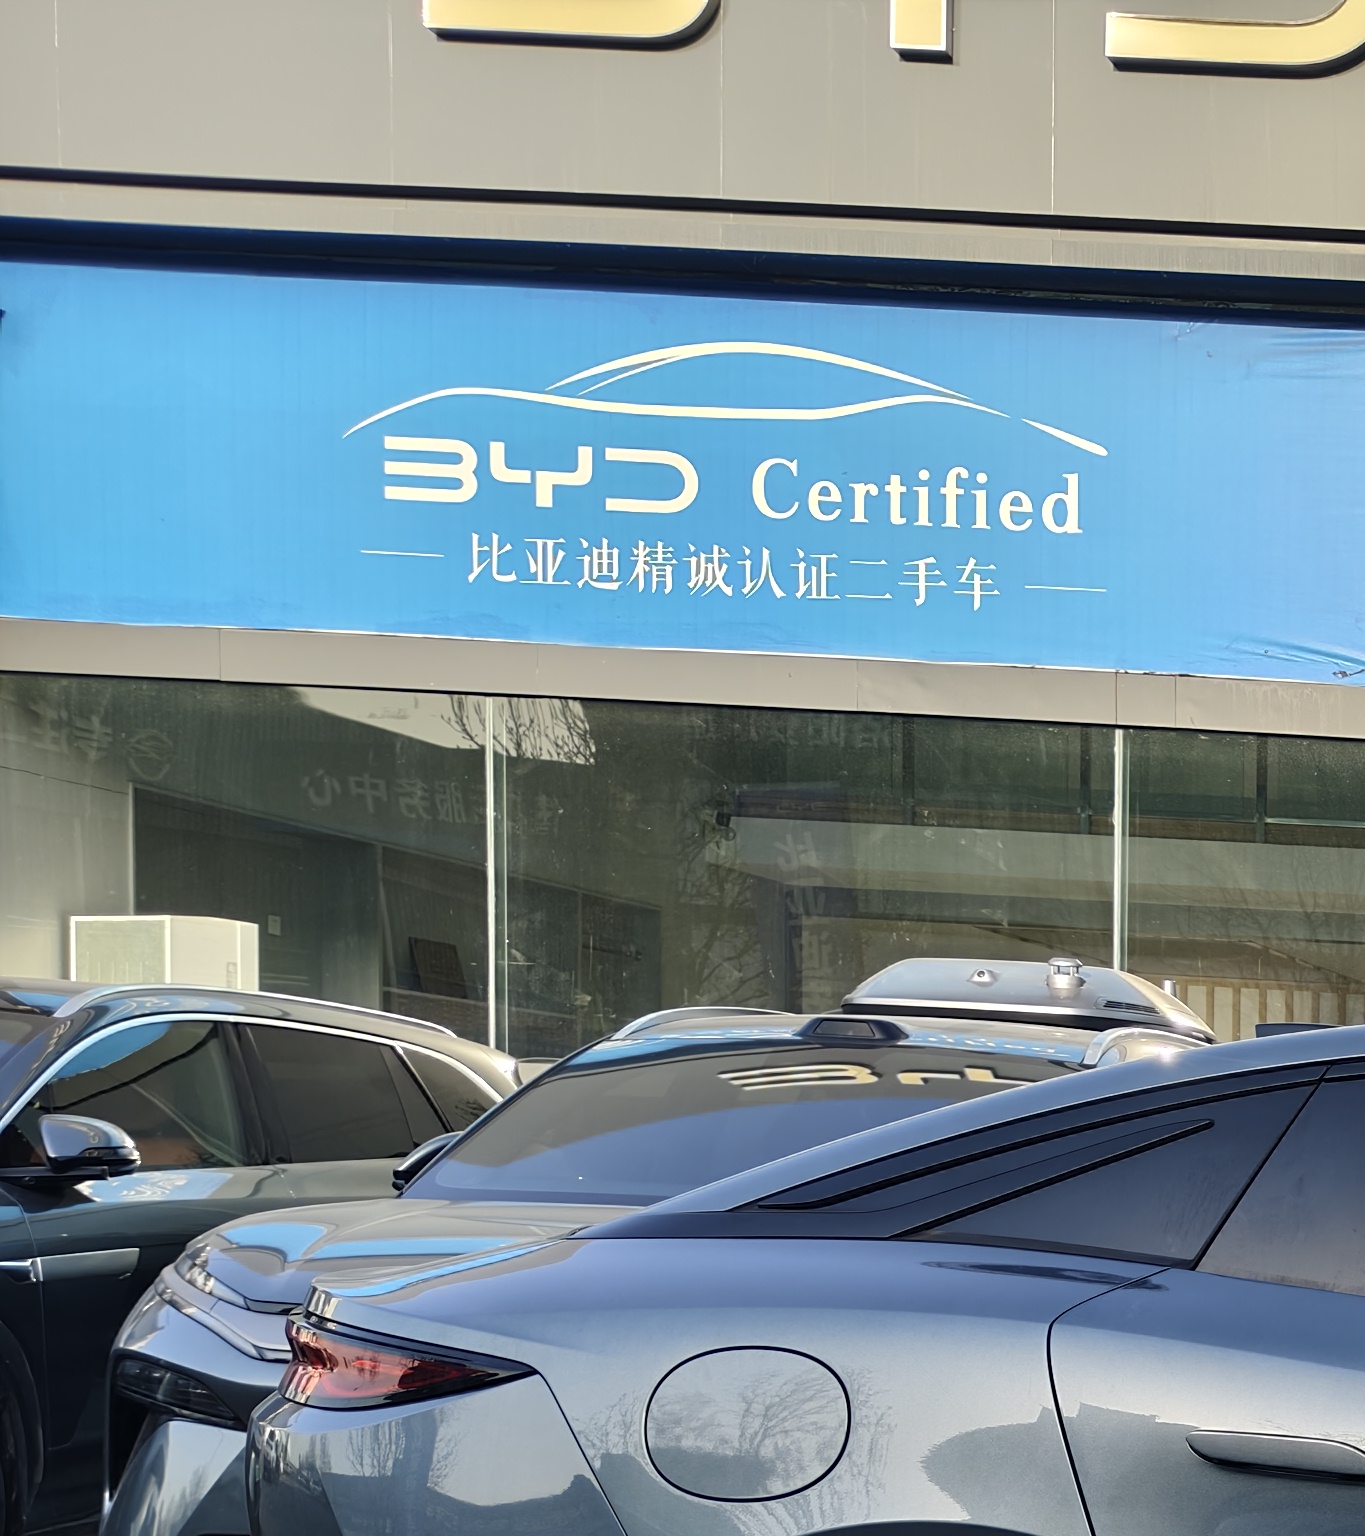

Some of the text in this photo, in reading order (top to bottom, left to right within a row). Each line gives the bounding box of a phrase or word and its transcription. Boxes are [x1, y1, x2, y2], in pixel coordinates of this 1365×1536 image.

[382, 435, 1083, 535] BYD Certified
[465, 531, 1002, 612] 比亚迪精诚认证二手车
